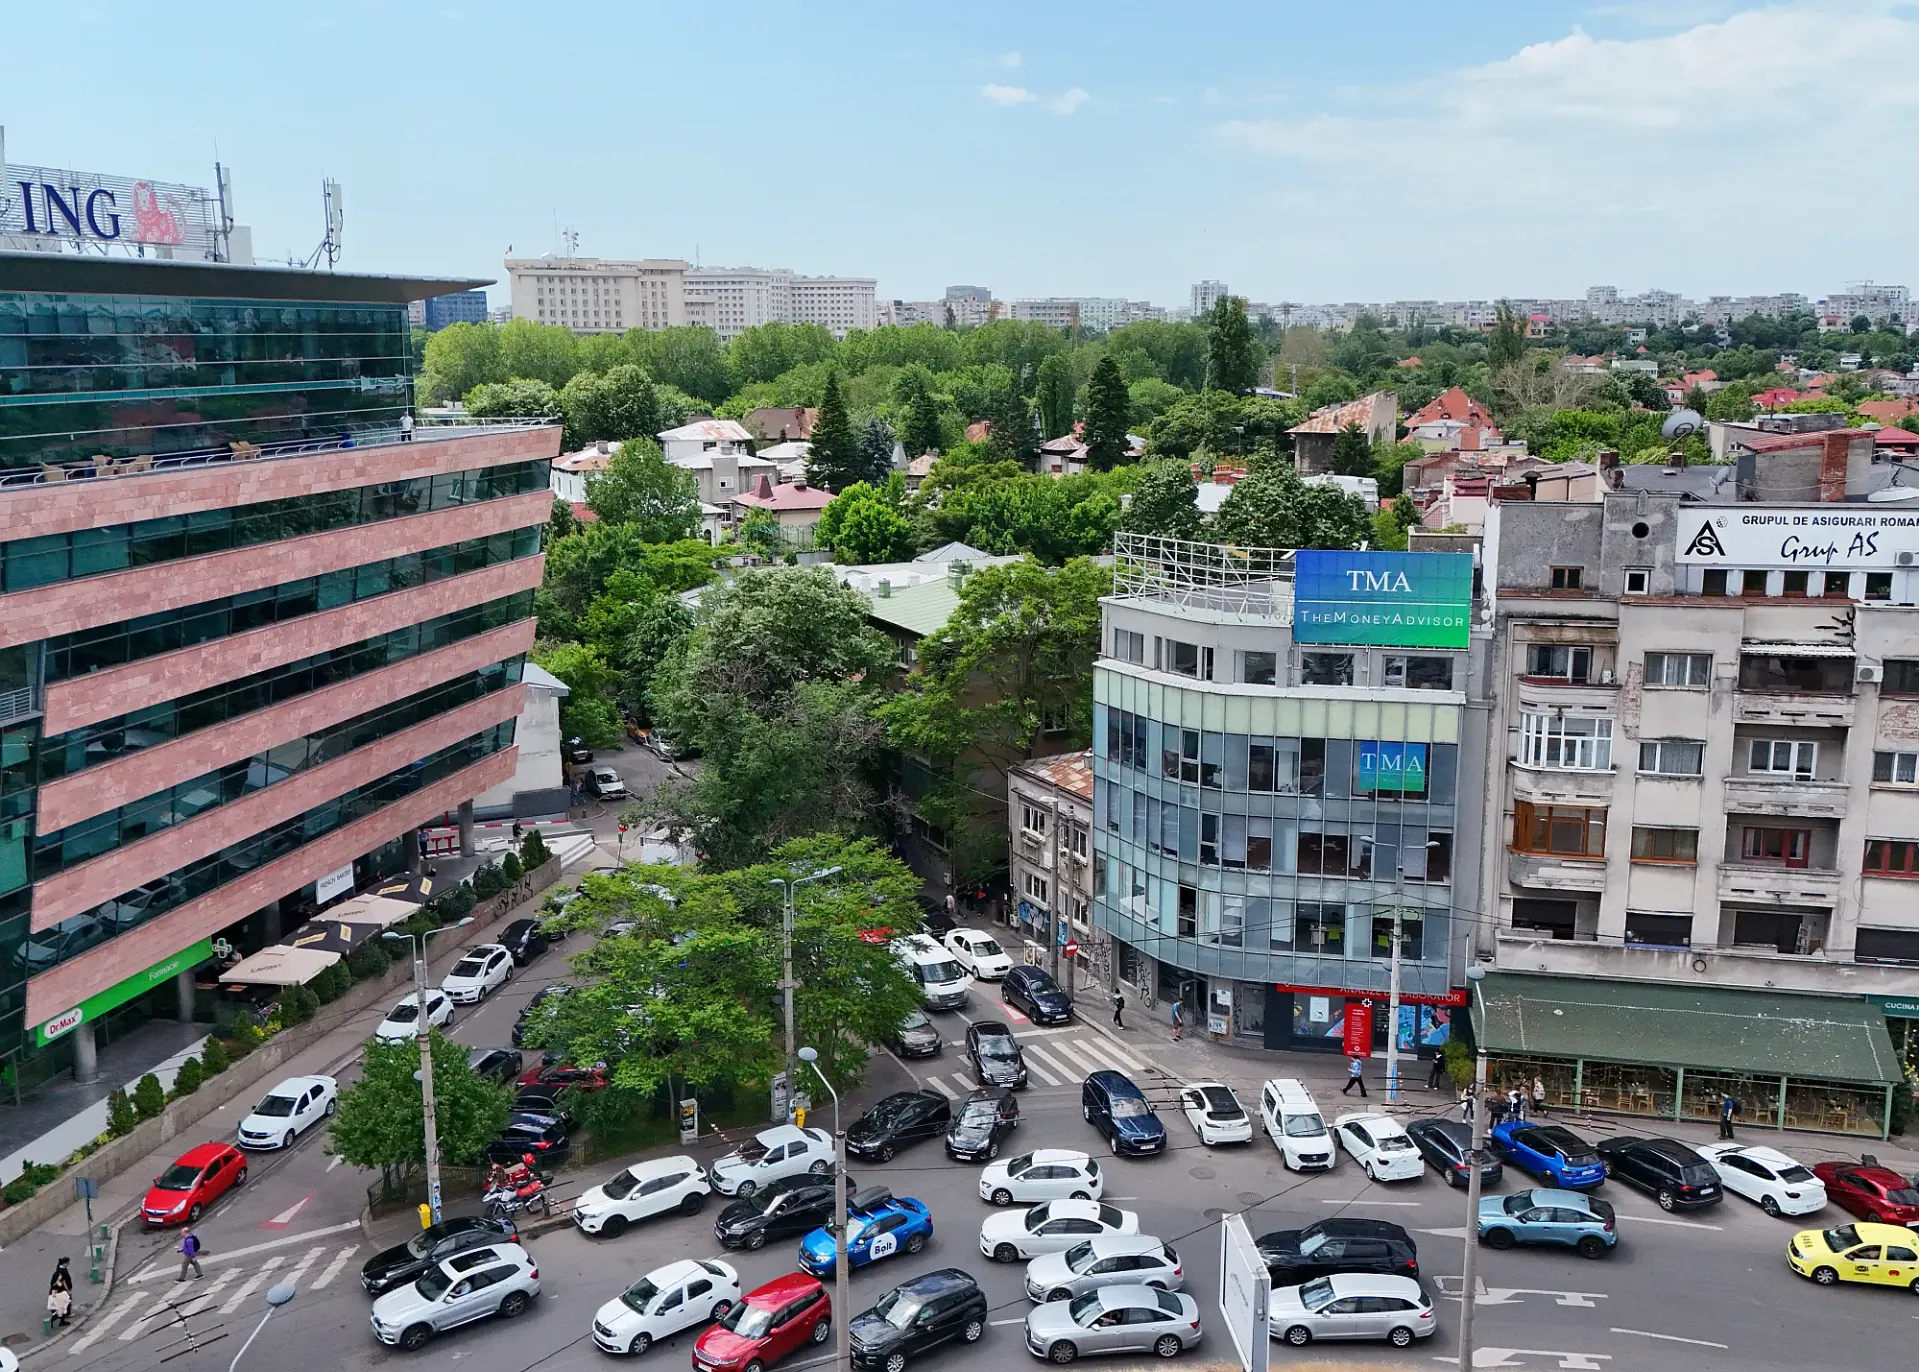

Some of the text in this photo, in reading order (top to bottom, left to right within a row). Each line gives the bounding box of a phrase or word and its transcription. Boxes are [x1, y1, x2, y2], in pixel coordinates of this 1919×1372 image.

[17, 181, 121, 240] ING
[1742, 515, 1789, 526] GRUPUL
[1793, 516, 1808, 526] DE
[1812, 516, 1876, 526] ASIGURARI
[1781, 531, 1880, 564] Grup AS
[1347, 570, 1412, 593] TMA
[1361, 752, 1423, 772] TMA
[149, 960, 179, 981] Farmacie
[1885, 1002, 1915, 1010] CUCINA
[874, 1242, 892, 1255] Bolt
